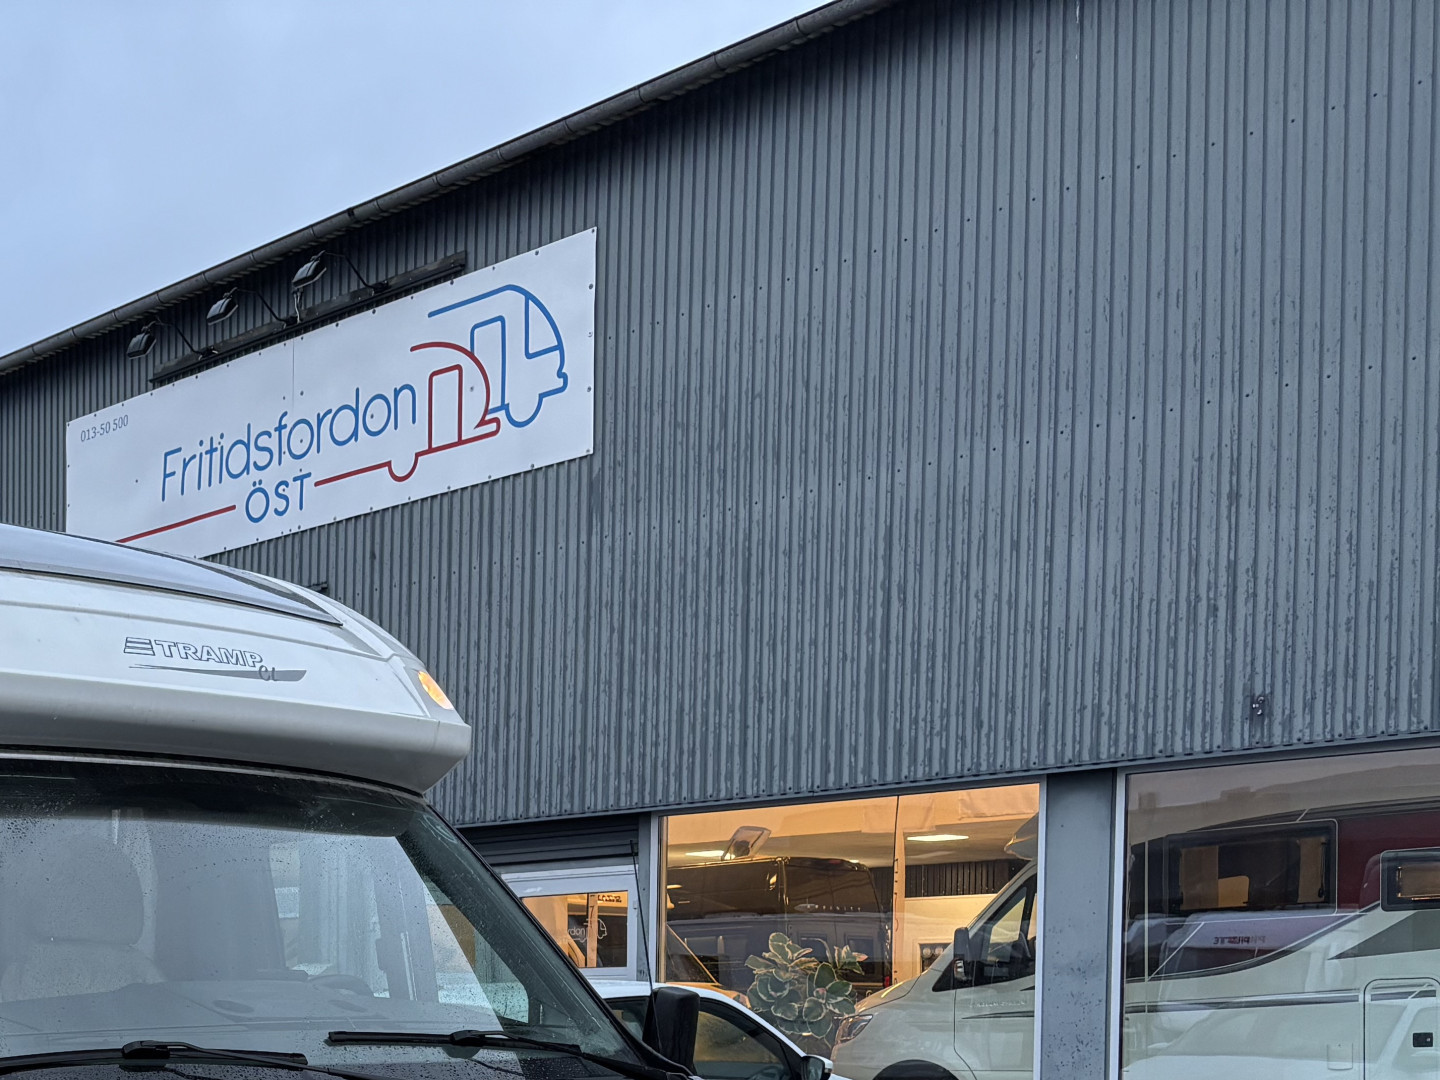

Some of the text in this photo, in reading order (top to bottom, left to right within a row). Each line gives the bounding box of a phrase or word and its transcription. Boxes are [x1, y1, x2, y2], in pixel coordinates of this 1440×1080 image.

[80, 414, 129, 442] 013-50 500
[161, 383, 417, 502] Fritidsfordon
[244, 472, 312, 524] ÖST
